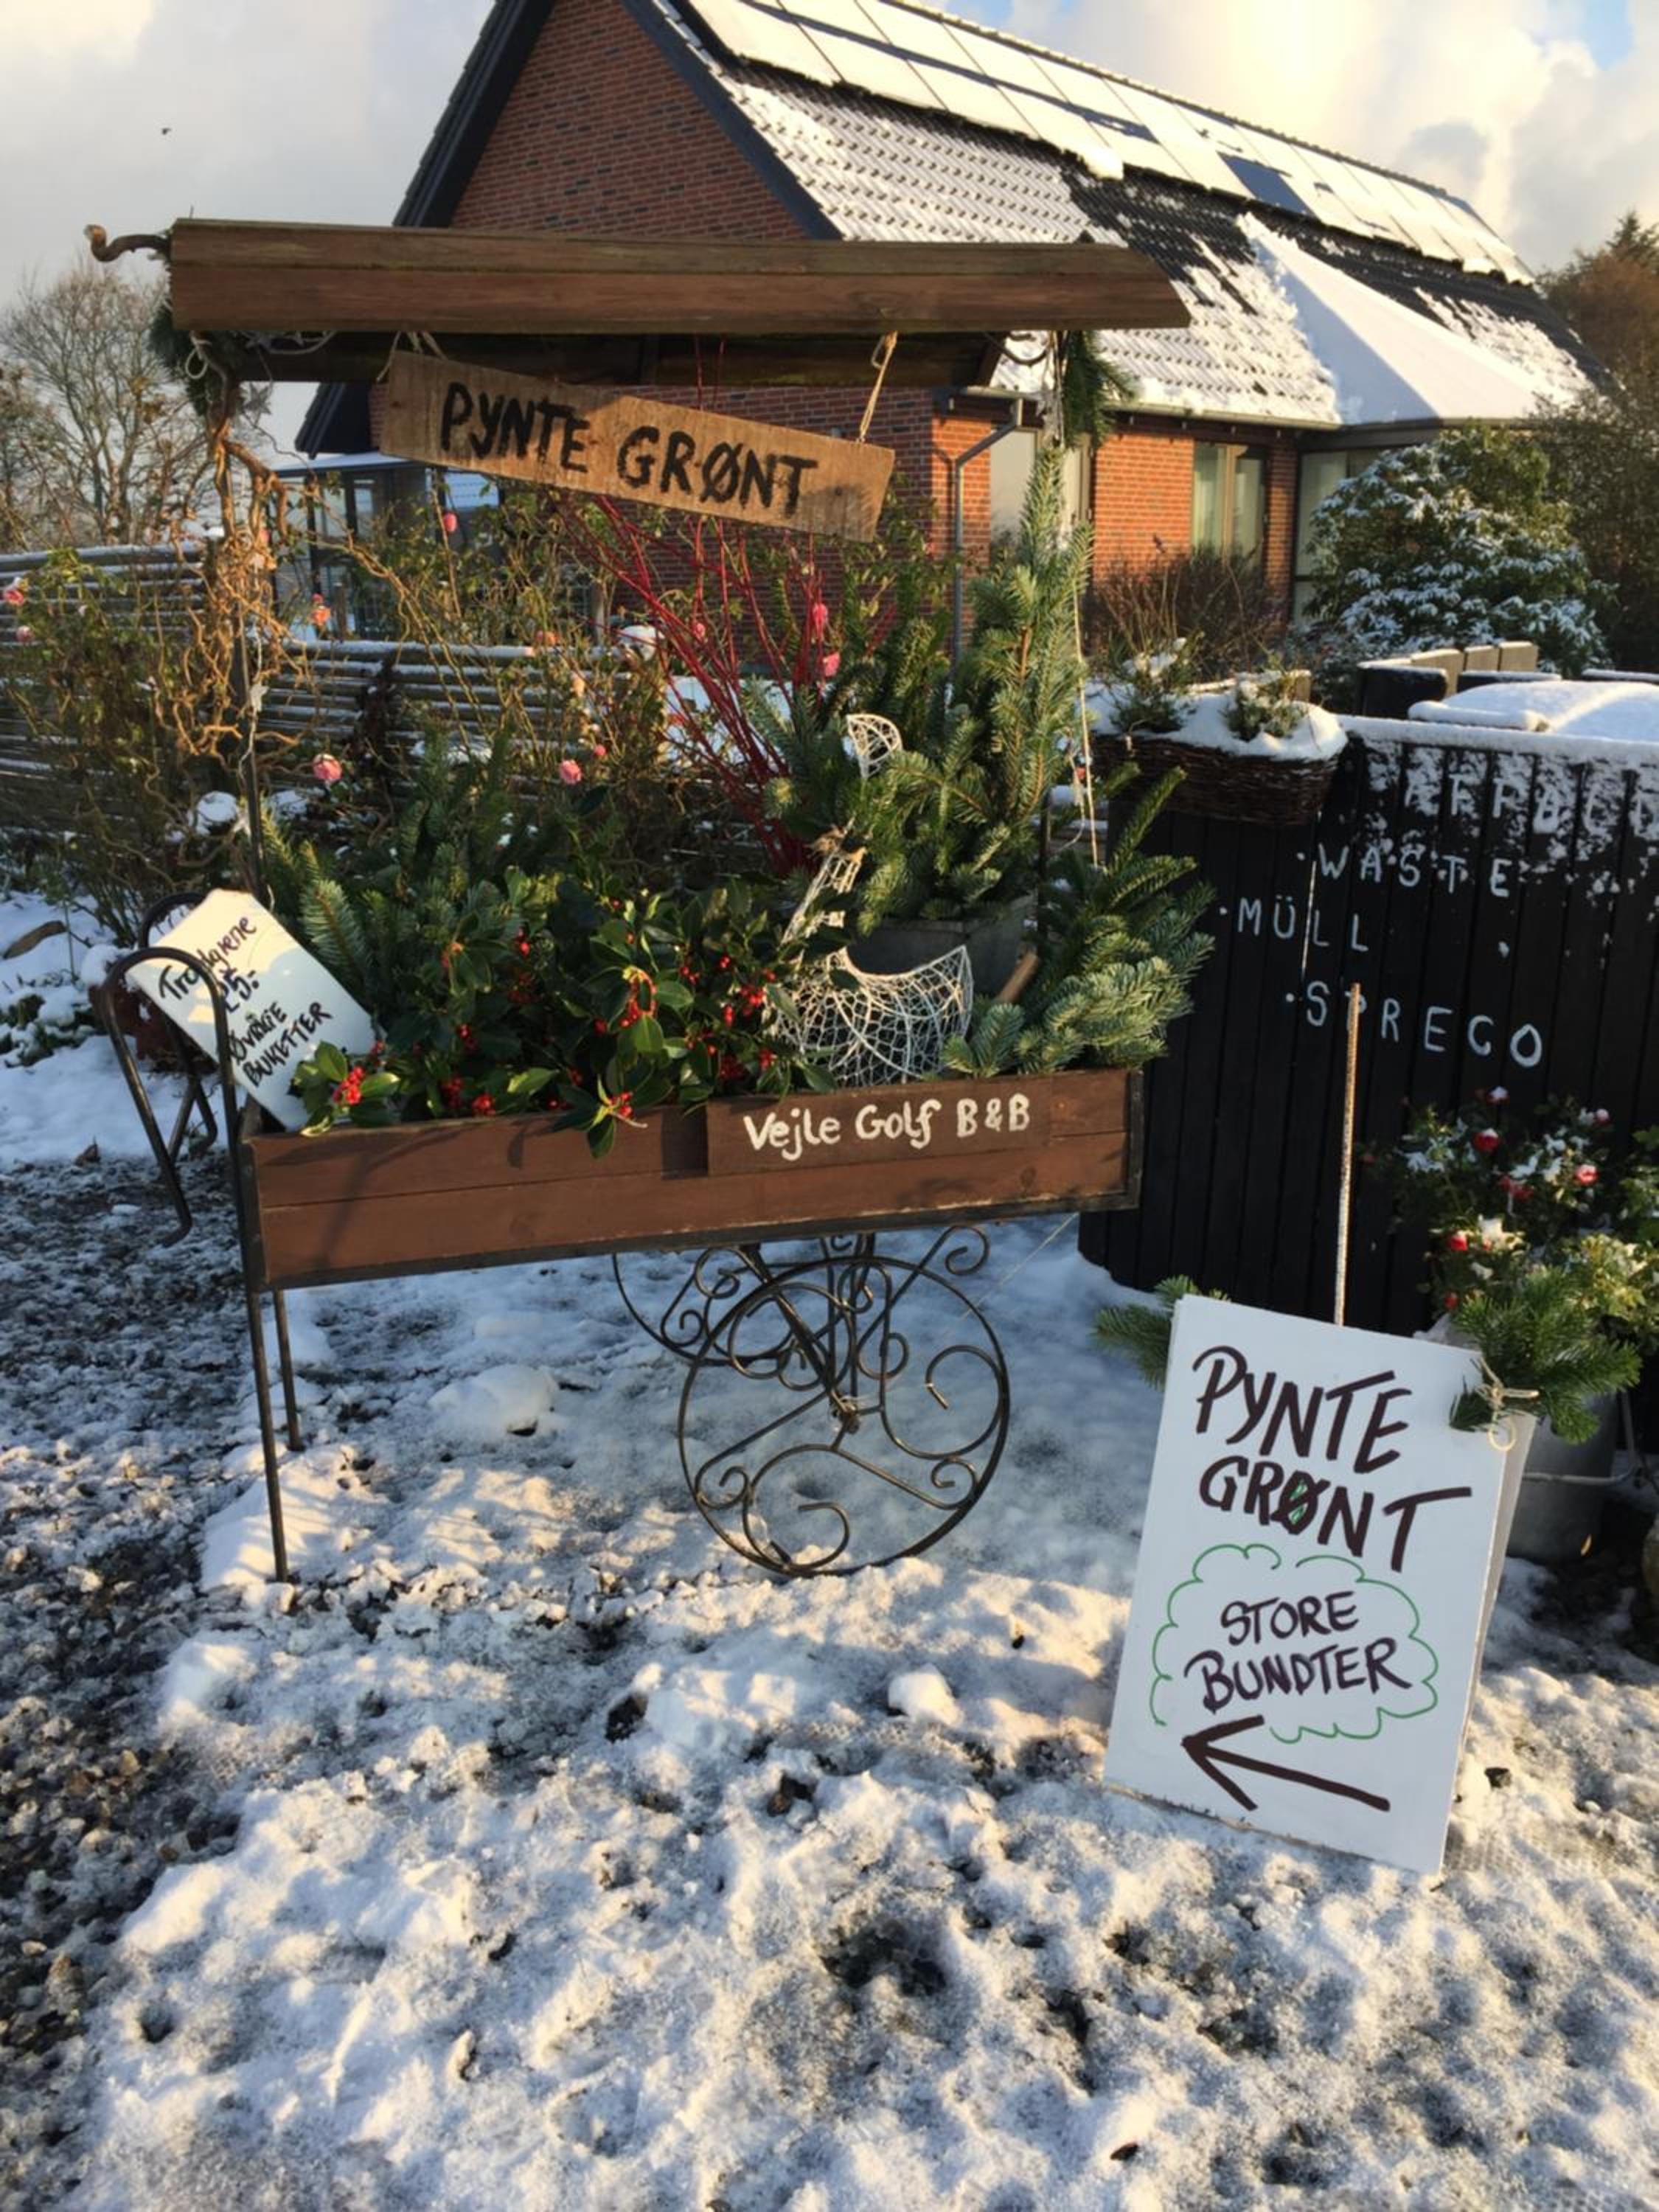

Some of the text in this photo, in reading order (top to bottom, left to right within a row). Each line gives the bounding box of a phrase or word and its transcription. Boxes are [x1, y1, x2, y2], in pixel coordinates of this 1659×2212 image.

[442, 381, 818, 515] PYNTE GRØNT
[1318, 843, 1514, 897] WASTE
[1238, 896, 1368, 952] MÜLL
[243, 1002, 333, 1088] BUKETTER
[743, 1093, 1030, 1161] Vejle Golf B&B
[1192, 1346, 1413, 1474] PYNTE
[1198, 1455, 1472, 1572] GRØNT
[1220, 1590, 1360, 1646] STORE
[1183, 1636, 1413, 1714] BUNDTER
